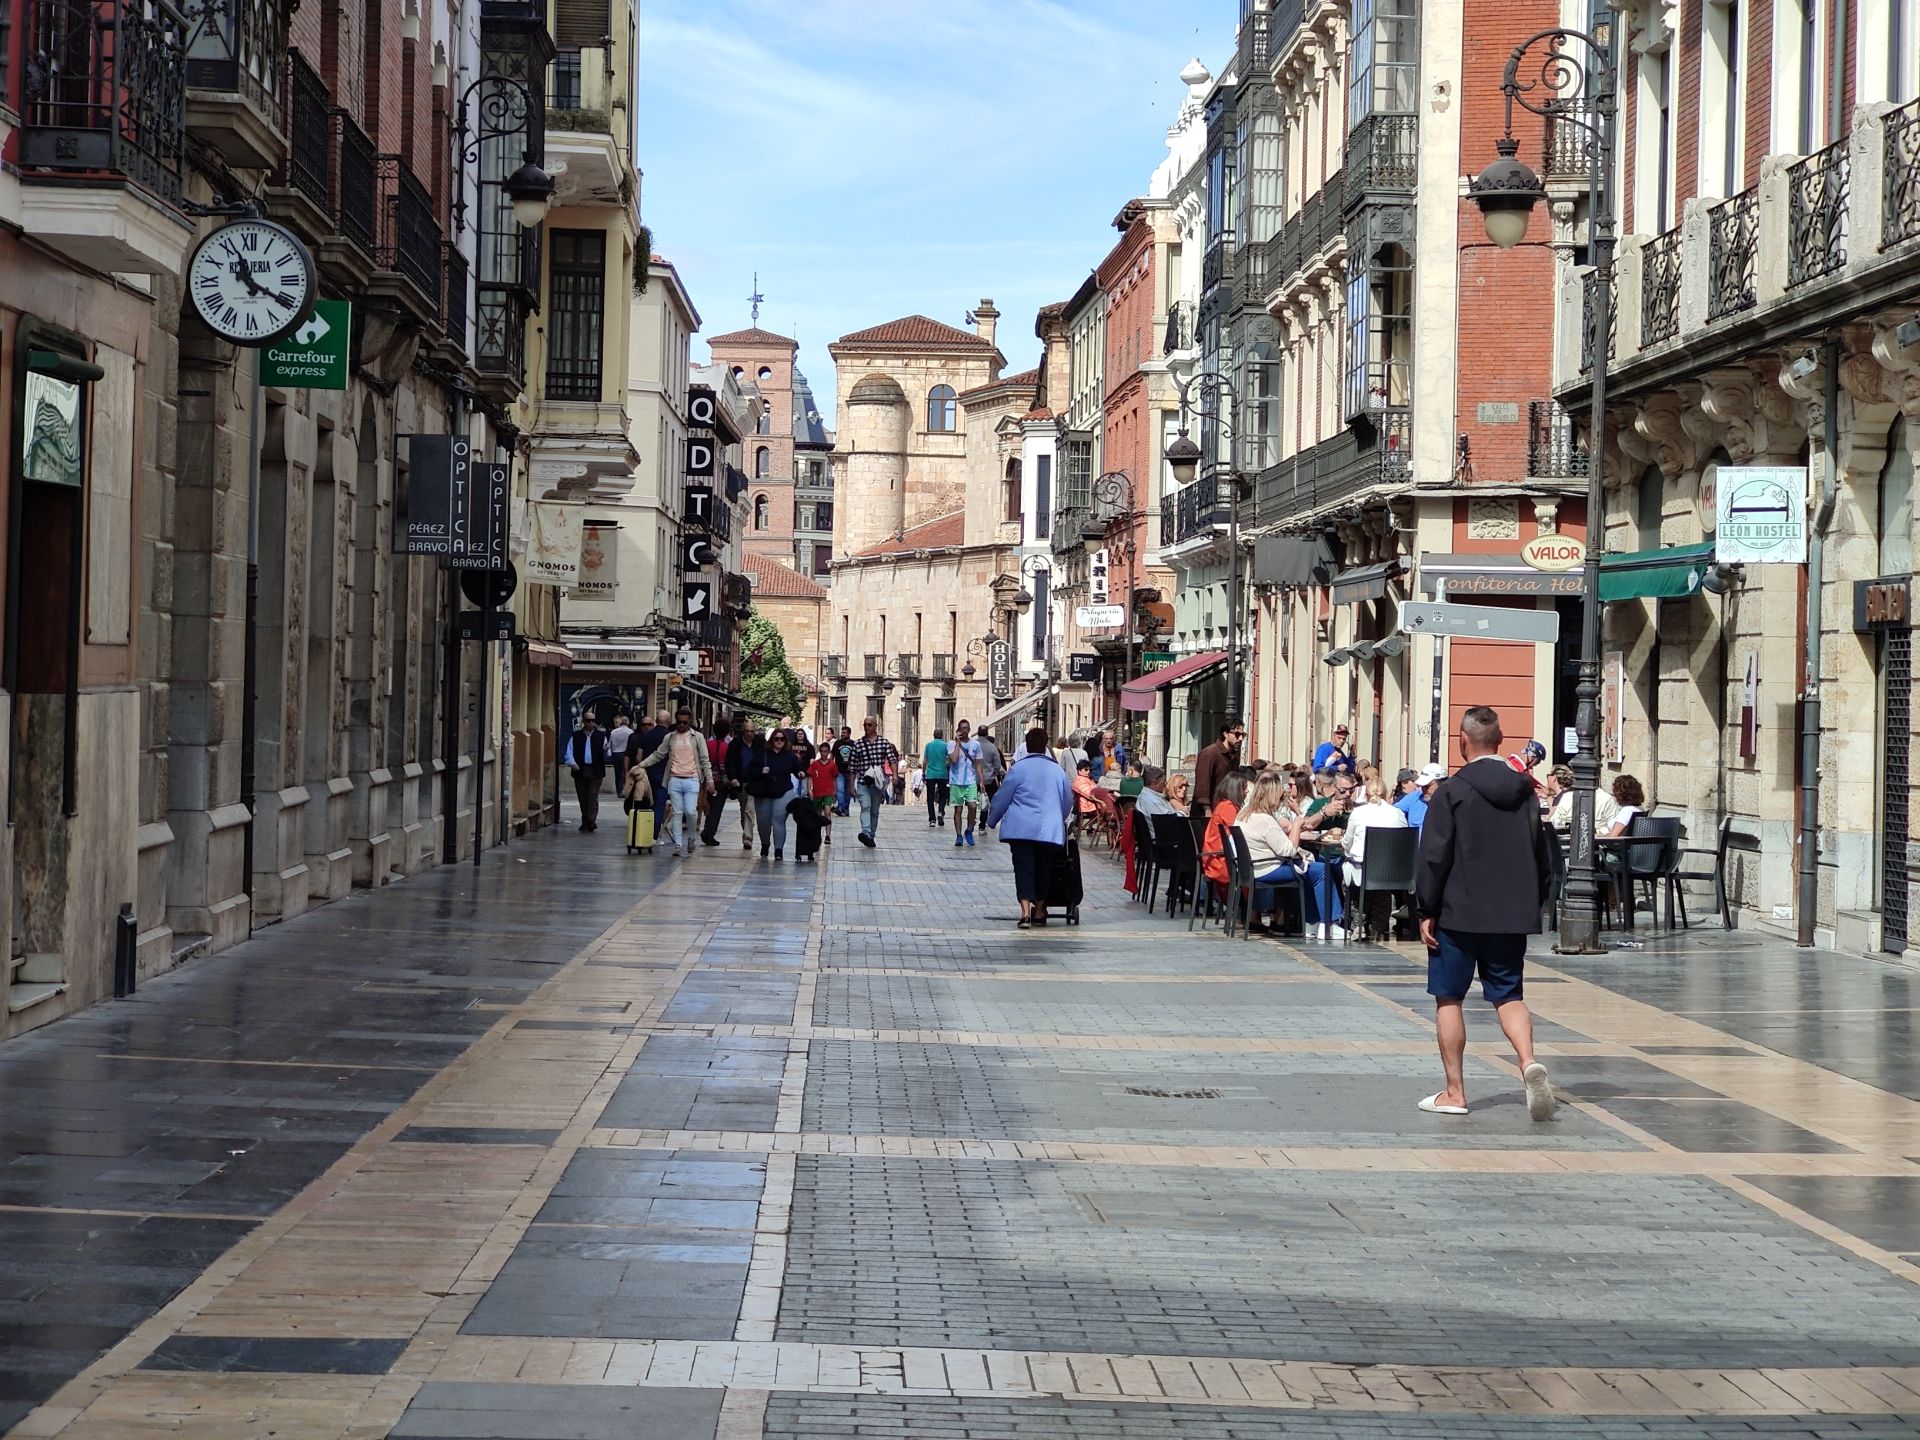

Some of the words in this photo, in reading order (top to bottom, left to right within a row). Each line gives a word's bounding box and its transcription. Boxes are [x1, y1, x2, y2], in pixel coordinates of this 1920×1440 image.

[241, 233, 257, 251] XII
[205, 255, 224, 270] X
[229, 261, 271, 273] REJERIA
[275, 253, 293, 268] II
[201, 275, 219, 288] IX
[281, 275, 299, 286] III
[204, 292, 225, 315] VIII
[221, 306, 238, 328] VII
[246, 313, 258, 330] VI
[268, 349, 336, 364] Carrefour
[276, 366, 327, 378] express
[454, 439, 468, 553] ÓPTICA
[491, 467, 505, 568] ÓPTICA
[408, 521, 445, 534] PÉREZ
[1756, 525, 1798, 537] HOSTEL
[408, 542, 448, 553] BRAVO
[1529, 546, 1582, 561] VALOR
[452, 558, 487, 568] BRAVO
[528, 560, 576, 572] GNOMOS
[578, 581, 613, 589] NOMOS
[1092, 552, 1107, 604] IRIS
[1443, 575, 1542, 593] onfitería
[1551, 578, 1583, 592] Hel
[994, 644, 1007, 688] HOTEL
